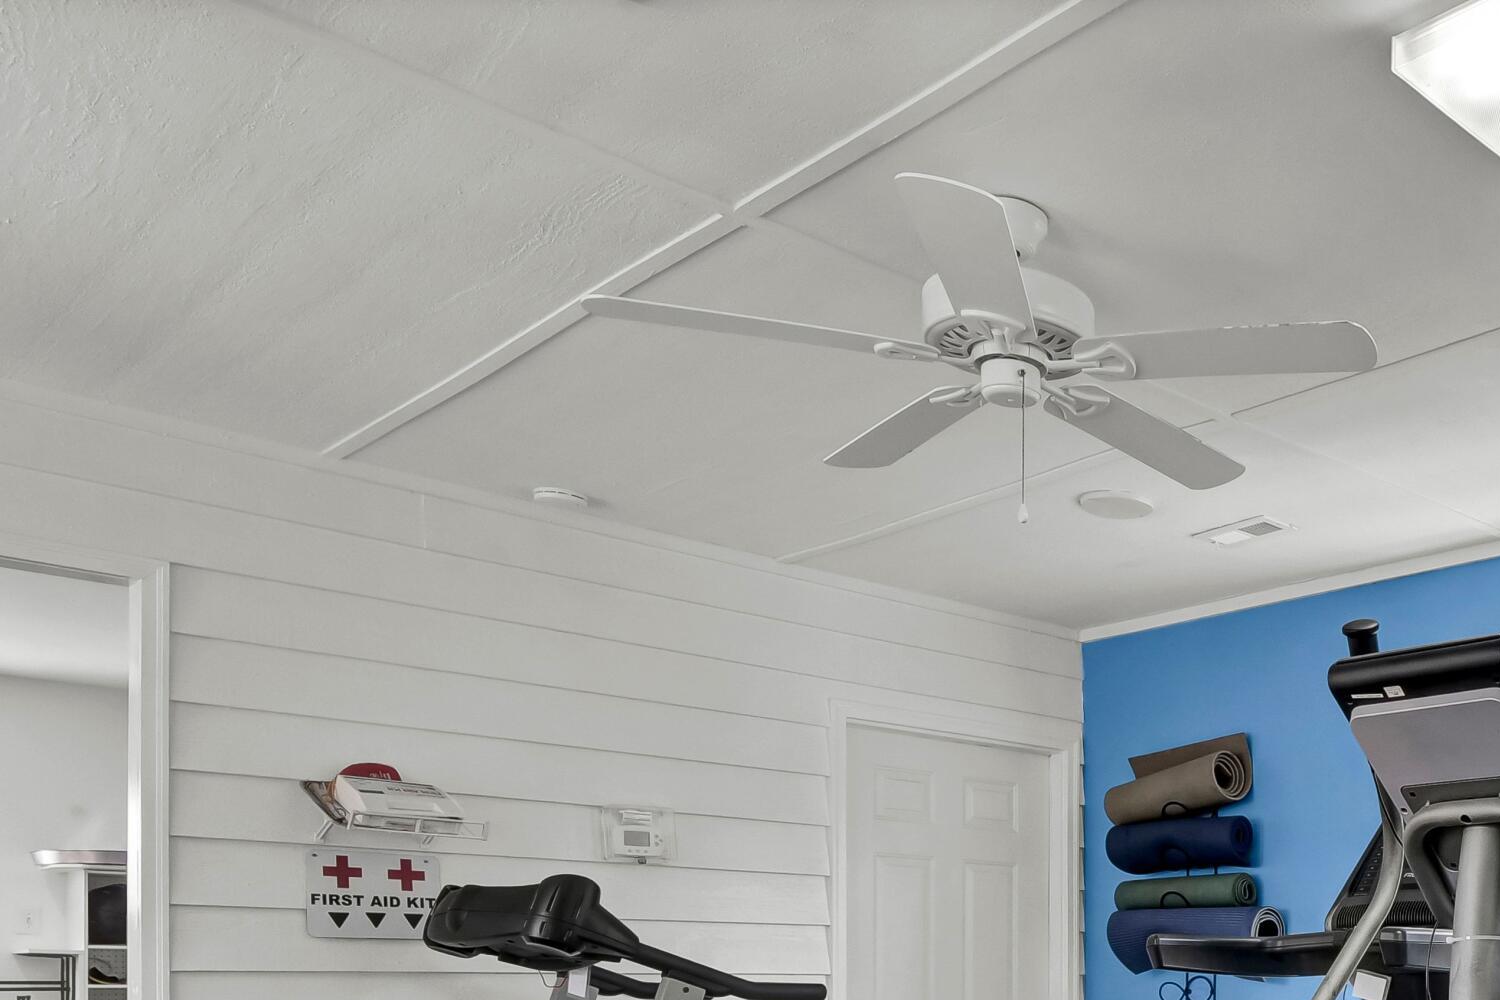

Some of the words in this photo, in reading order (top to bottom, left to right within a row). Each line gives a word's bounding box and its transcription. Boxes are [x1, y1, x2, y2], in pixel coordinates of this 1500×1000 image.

[310, 893, 364, 907] FIRST
[370, 896, 401, 908] AID
[407, 897, 436, 909] KIT
